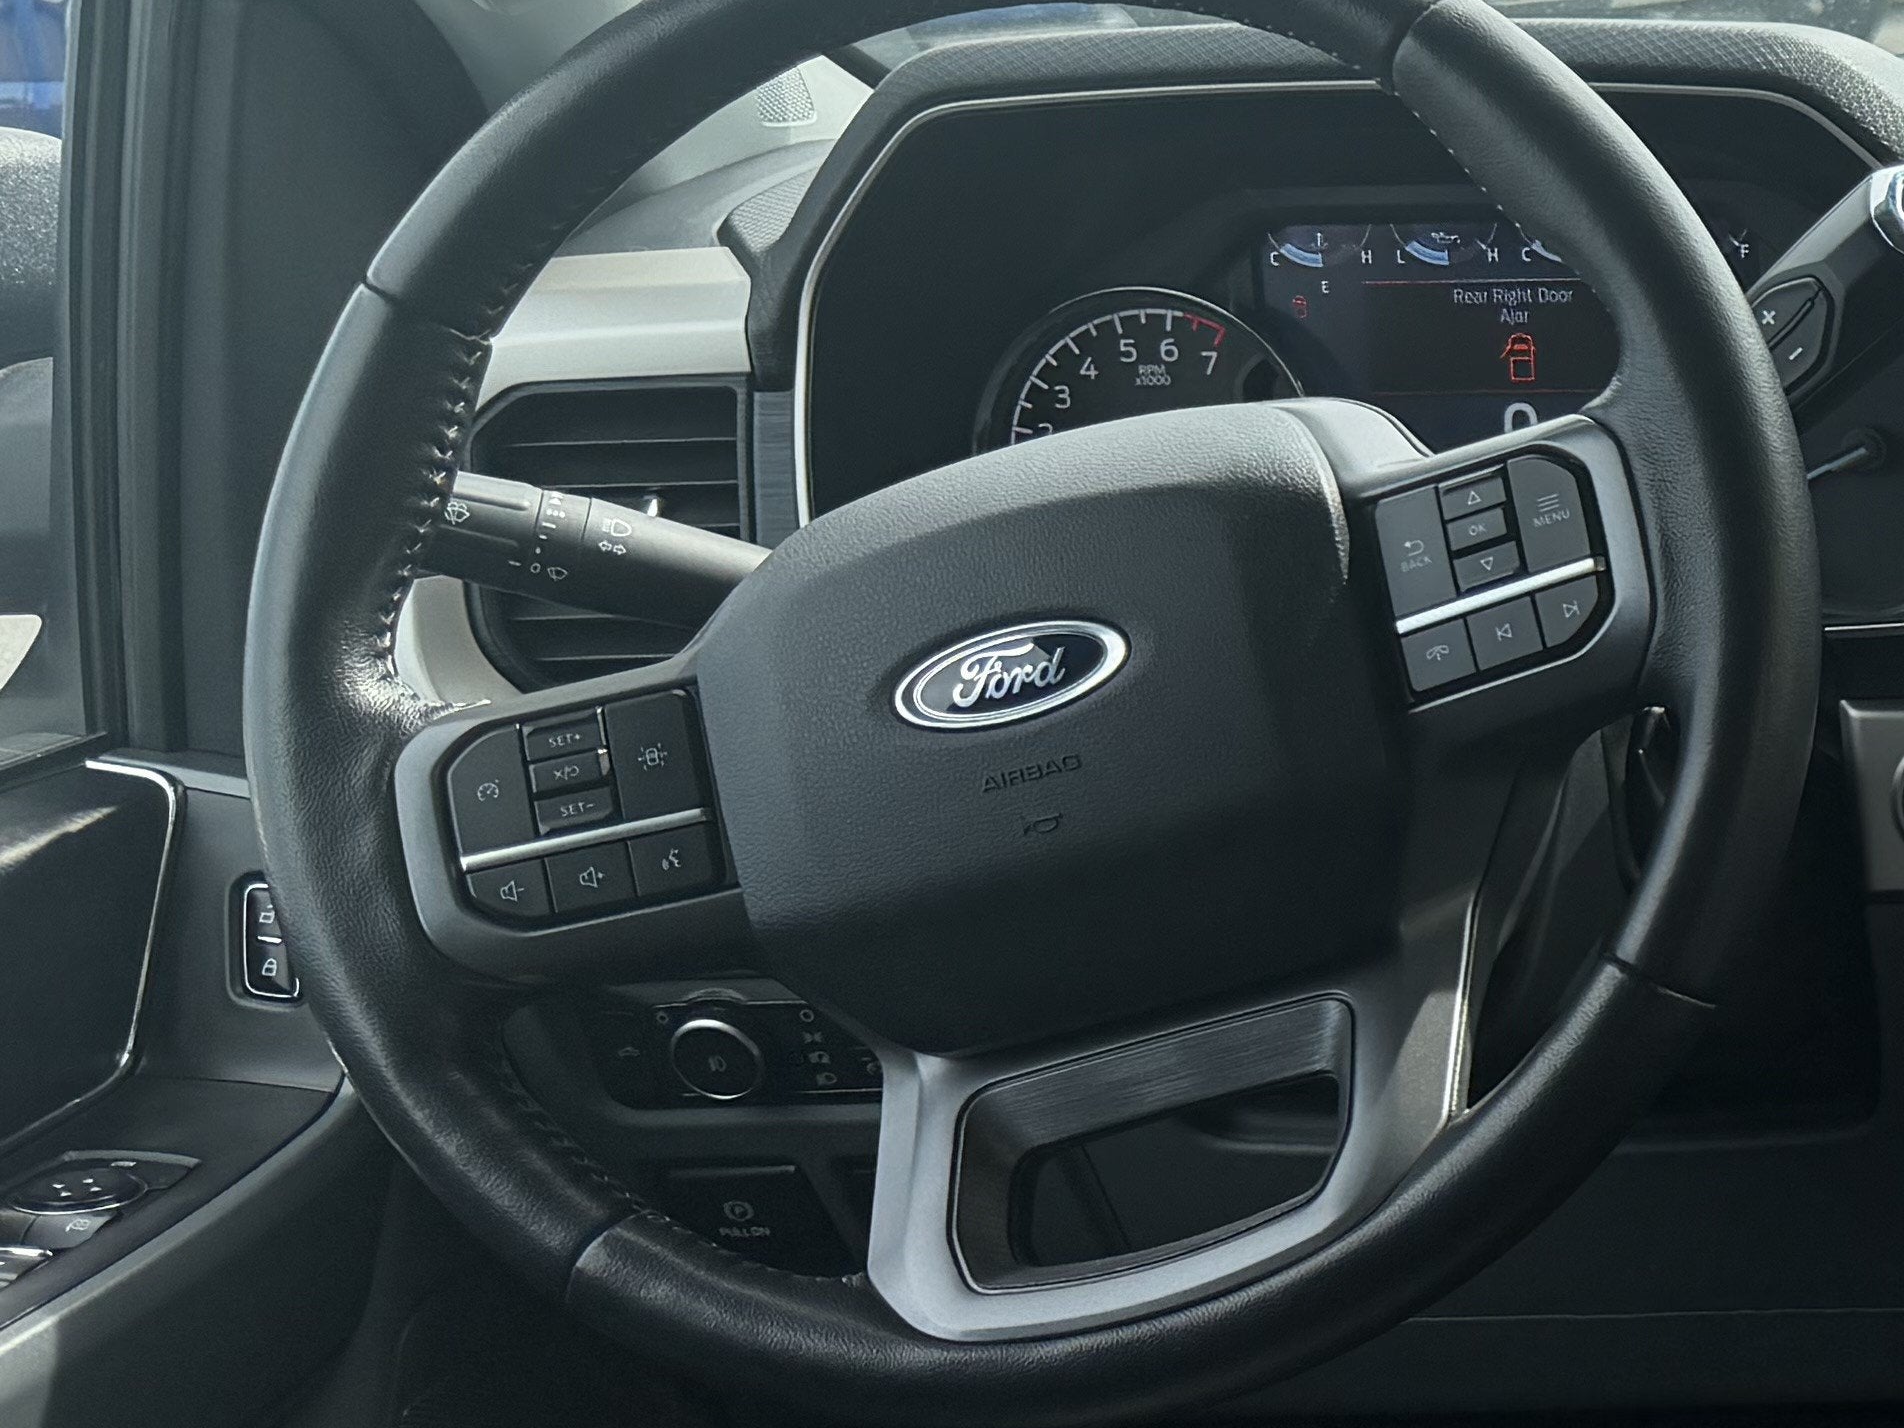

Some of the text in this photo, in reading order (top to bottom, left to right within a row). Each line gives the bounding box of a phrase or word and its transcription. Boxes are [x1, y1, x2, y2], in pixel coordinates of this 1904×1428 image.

[1270, 251, 1279, 266] C
[1361, 250, 1372, 264] H
[1397, 250, 1405, 264] L
[1487, 249, 1499, 263] H
[1521, 247, 1531, 262] C
[1321, 281, 1330, 294] E
[1453, 288, 1574, 306] Rear Right Door
[1501, 309, 1529, 325] Ajar
[1120, 339, 1137, 362] 5
[1160, 338, 1179, 362] 6
[1080, 357, 1098, 379] 4
[1138, 364, 1166, 375] RPM
[1201, 351, 1218, 375] 7
[1054, 385, 1071, 409] 3
[1533, 510, 1571, 528] MENU
[1469, 523, 1487, 536] OK
[1401, 555, 1433, 573] BACK
[952, 642, 1066, 708] Ford
[982, 754, 1082, 793] AIRBAG
